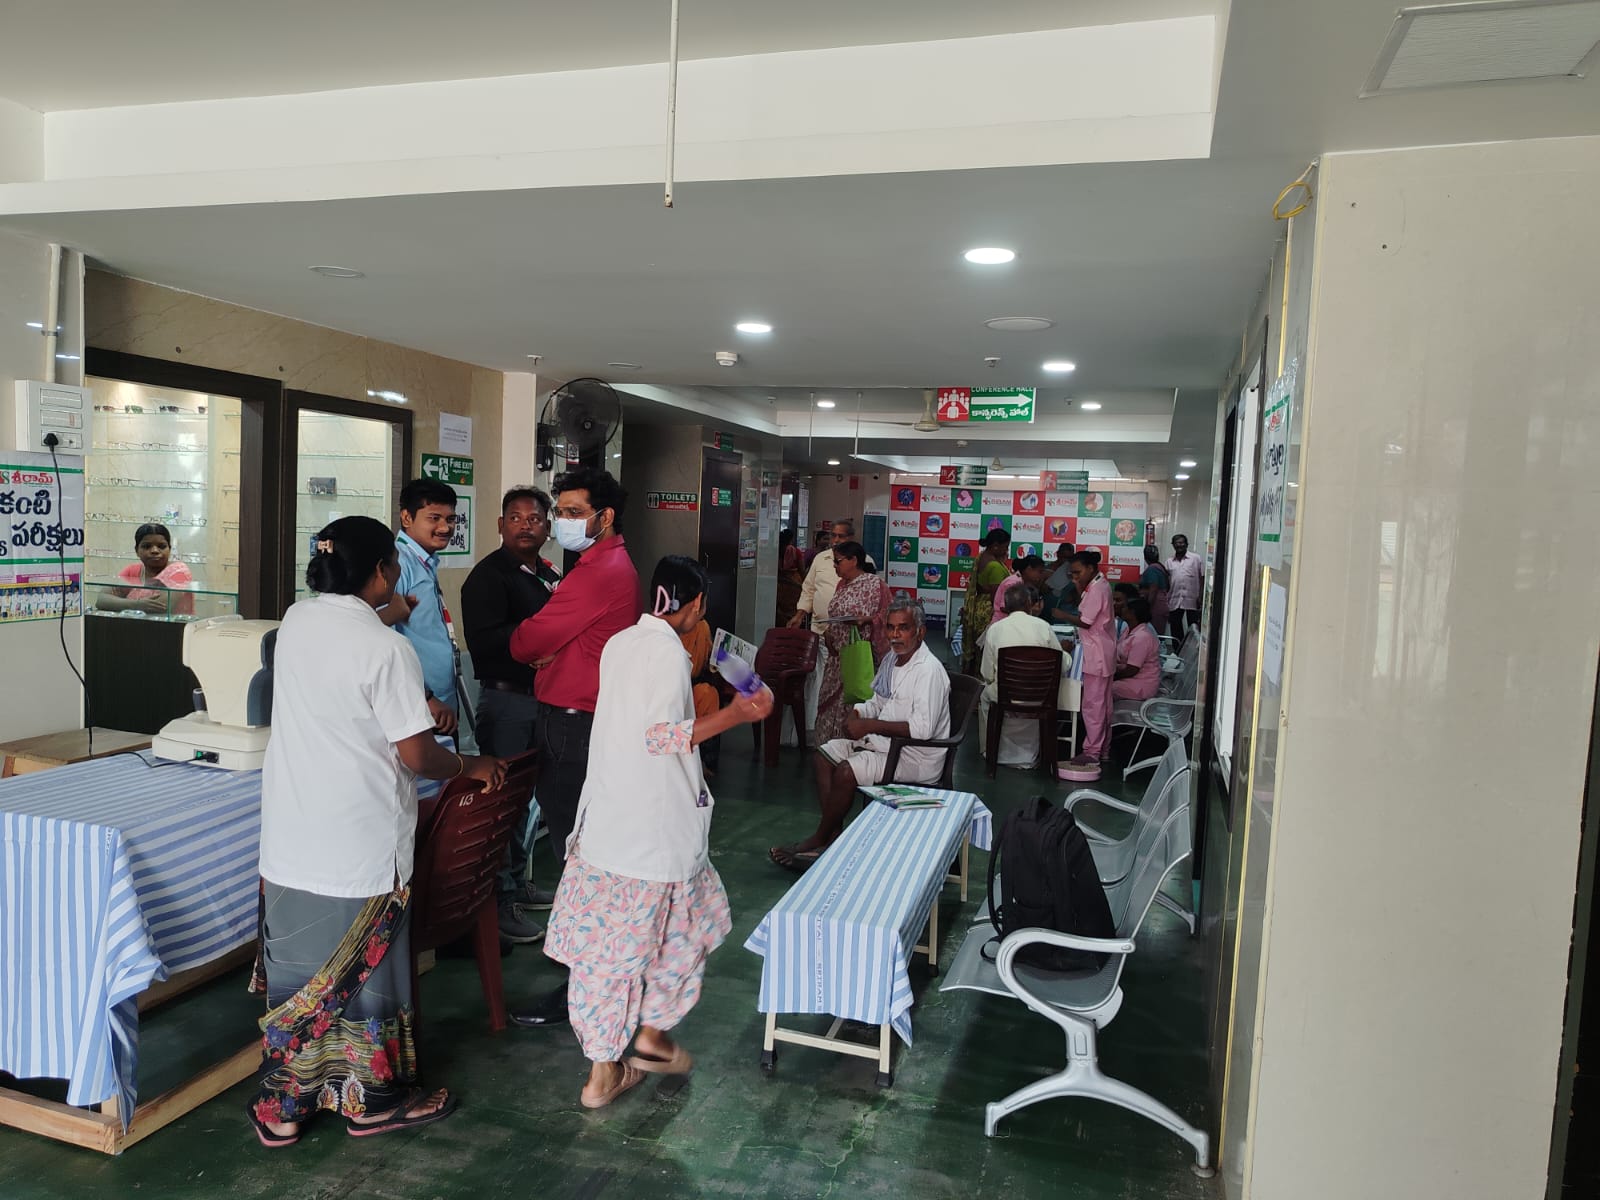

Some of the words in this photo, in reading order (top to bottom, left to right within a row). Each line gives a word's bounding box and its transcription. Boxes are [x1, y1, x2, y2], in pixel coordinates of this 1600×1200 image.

[449, 458, 461, 468] FIRE
[462, 461, 473, 469] EXIT
[660, 493, 697, 502] TOILETS
